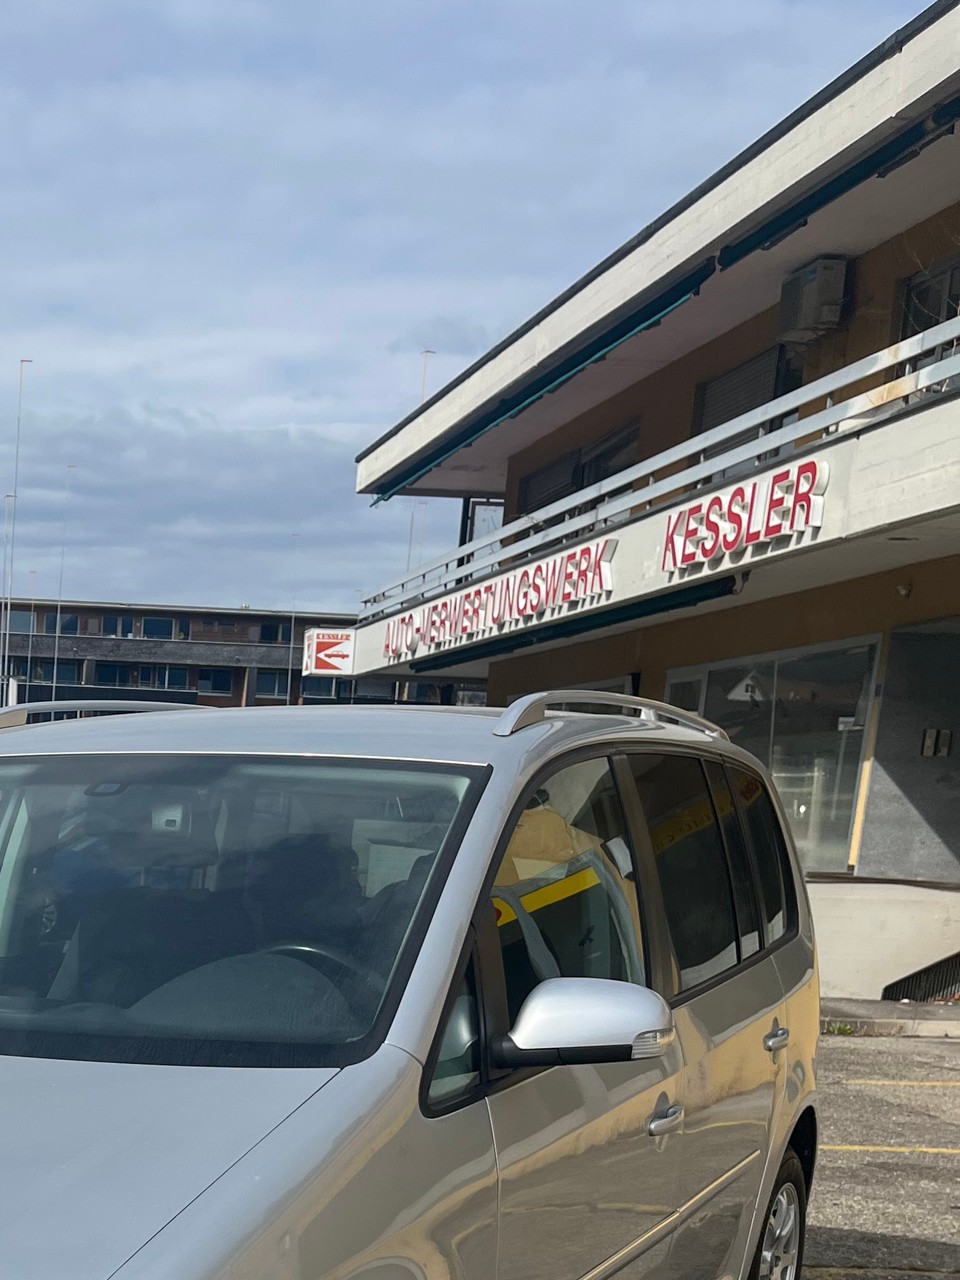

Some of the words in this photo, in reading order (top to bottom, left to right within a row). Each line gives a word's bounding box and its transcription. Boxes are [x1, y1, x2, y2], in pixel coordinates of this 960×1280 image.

[383, 539, 613, 657] AUTO-VERWERTUNGSWERK
[662, 460, 821, 572] KESSLER
[316, 633, 351, 641] KESSLER
